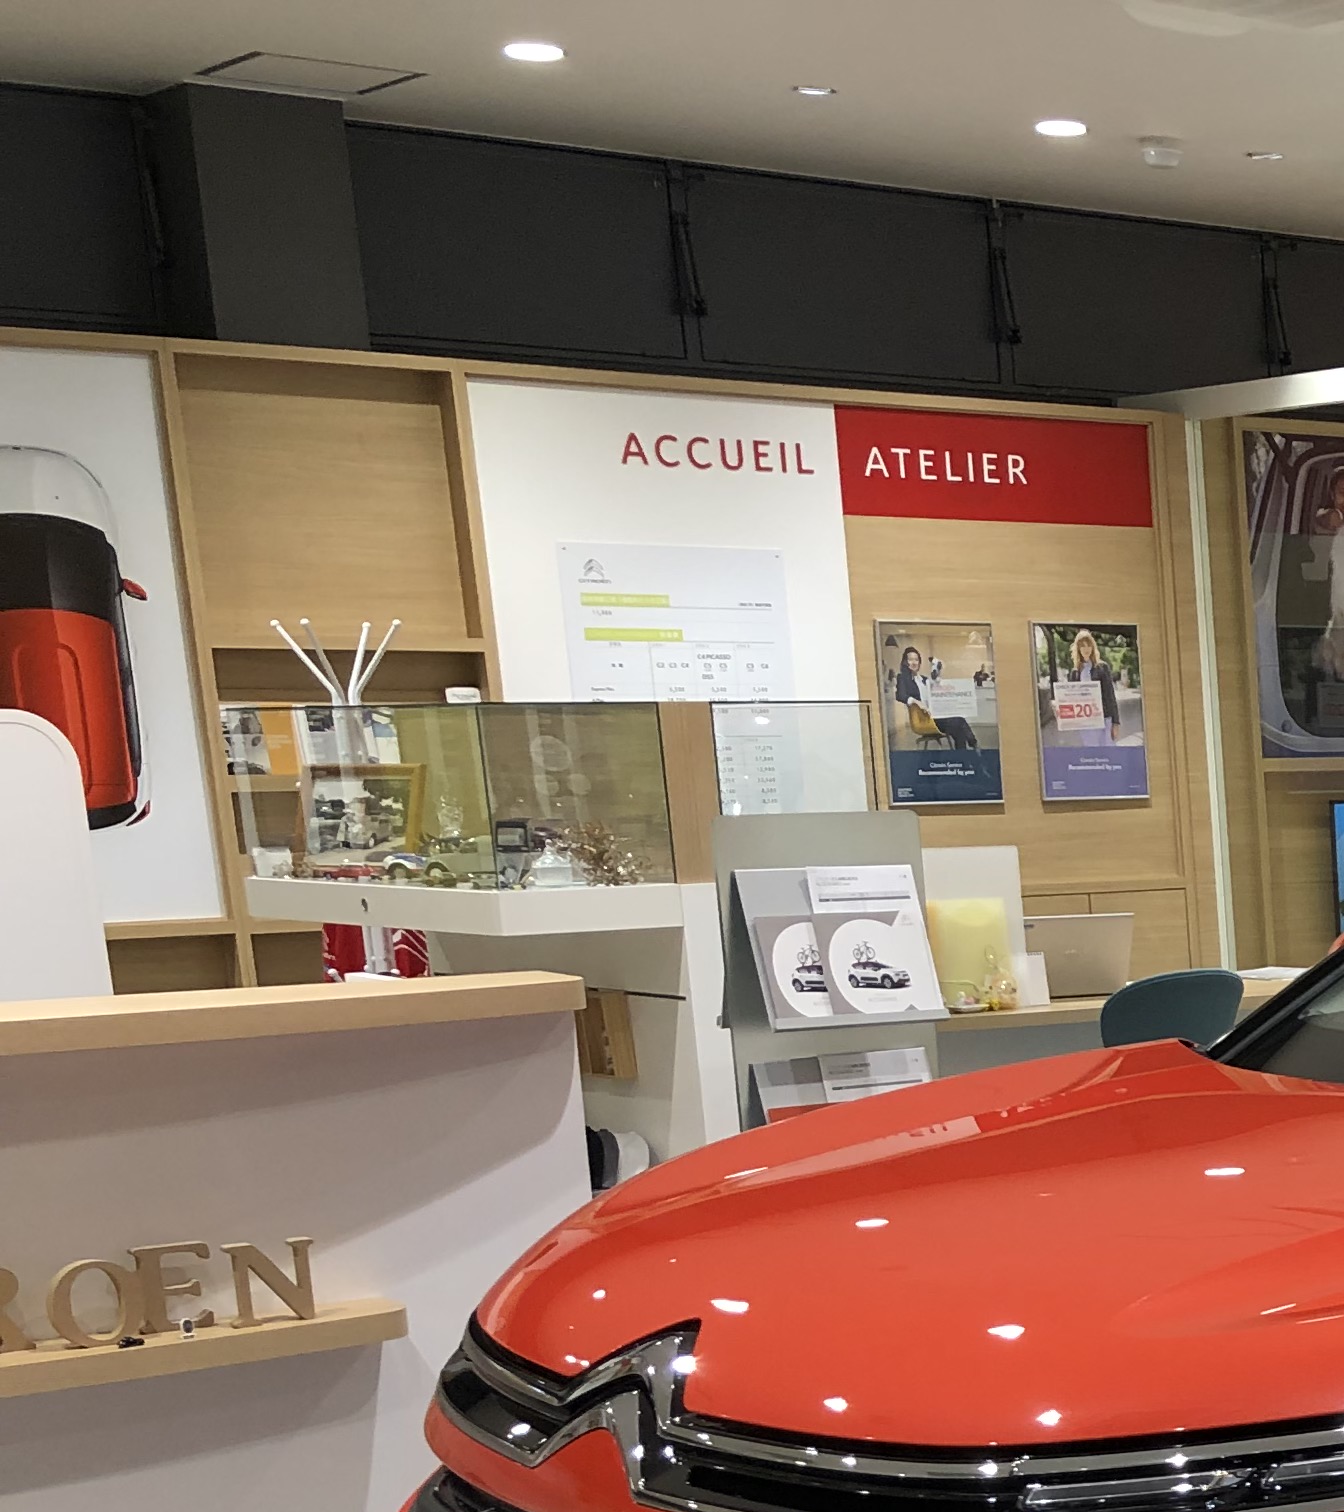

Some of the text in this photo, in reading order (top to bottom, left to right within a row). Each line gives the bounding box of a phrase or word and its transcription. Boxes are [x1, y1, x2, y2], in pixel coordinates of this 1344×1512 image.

[621, 432, 815, 475] ACCUEIL
[864, 446, 1028, 485] ATELIER
[1075, 704, 1093, 718] 20
